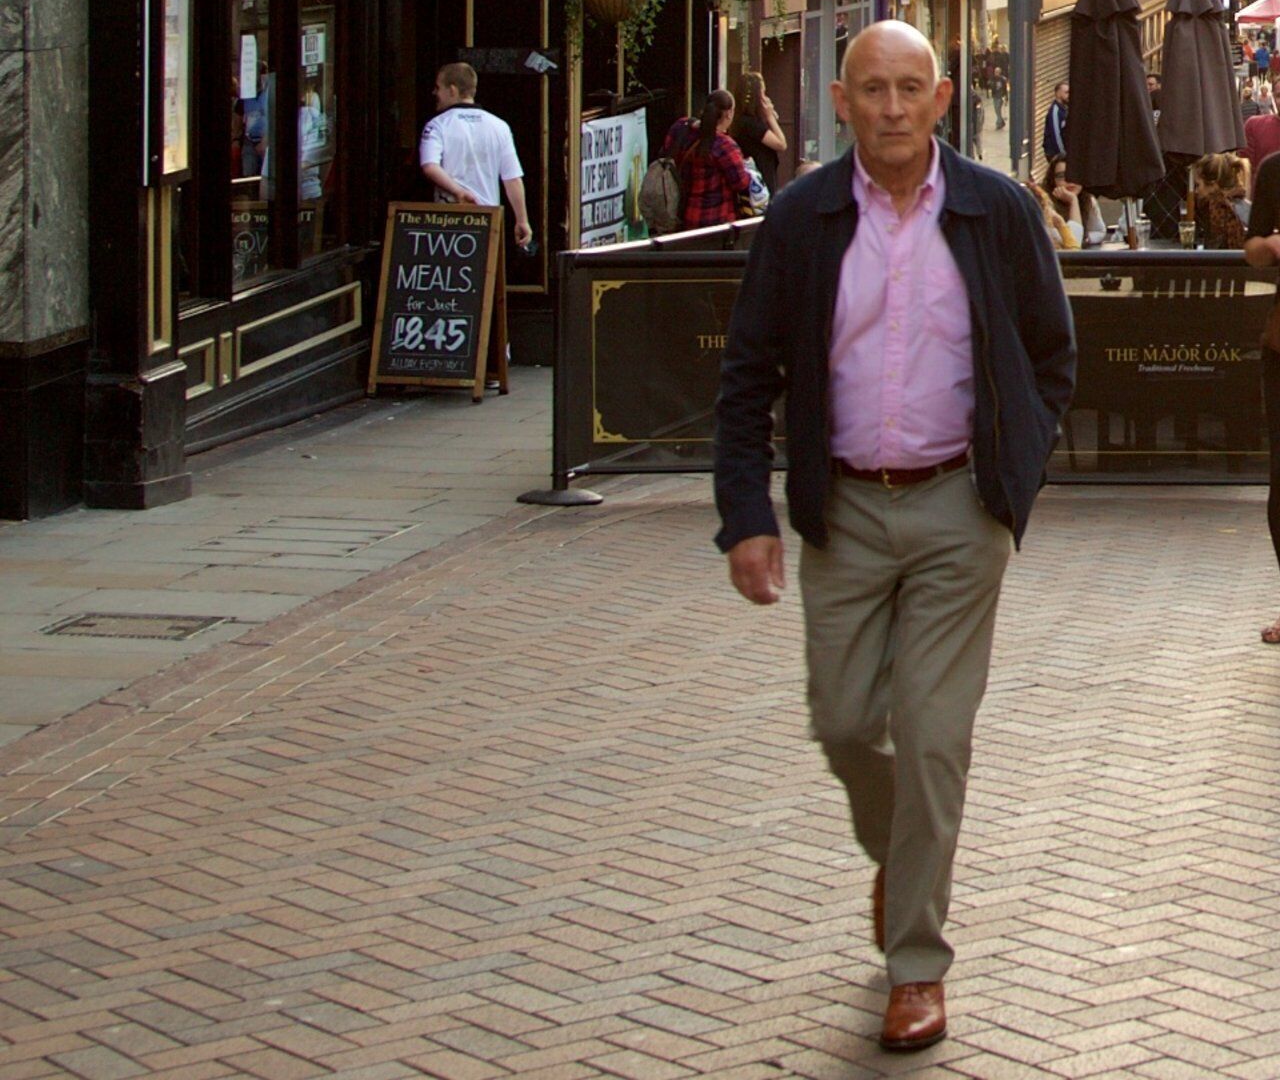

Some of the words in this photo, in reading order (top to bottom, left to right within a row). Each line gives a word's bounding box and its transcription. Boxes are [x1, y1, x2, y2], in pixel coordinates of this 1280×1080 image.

[399, 212, 422, 224] The
[424, 213, 460, 228] Major
[463, 214, 488, 227] Oak
[408, 231, 477, 259] TWO
[406, 295, 424, 312] for
[391, 316, 469, 352] £8.45
[1104, 347, 1138, 363] THE
[1142, 346, 1201, 364] MAJOR
[1204, 346, 1243, 363] OAK
